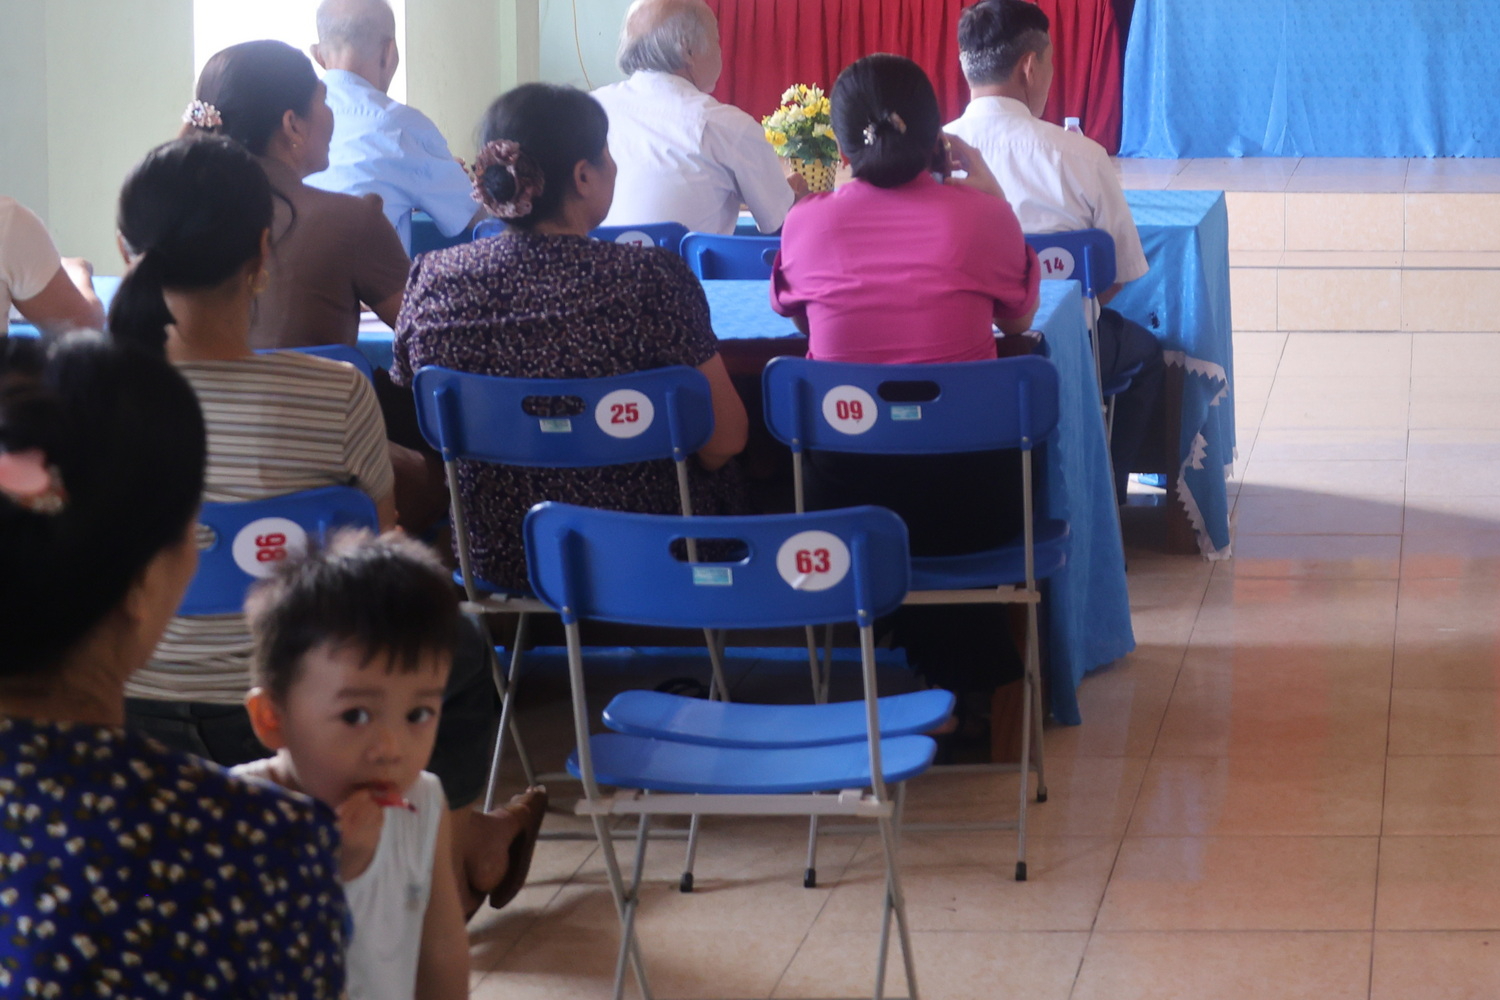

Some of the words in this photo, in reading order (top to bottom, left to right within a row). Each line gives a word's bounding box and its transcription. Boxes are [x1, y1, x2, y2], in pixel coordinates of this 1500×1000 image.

[1043, 256, 1065, 274] 14
[609, 402, 639, 425] 25
[835, 399, 864, 421] 09
[795, 548, 831, 575] 63
